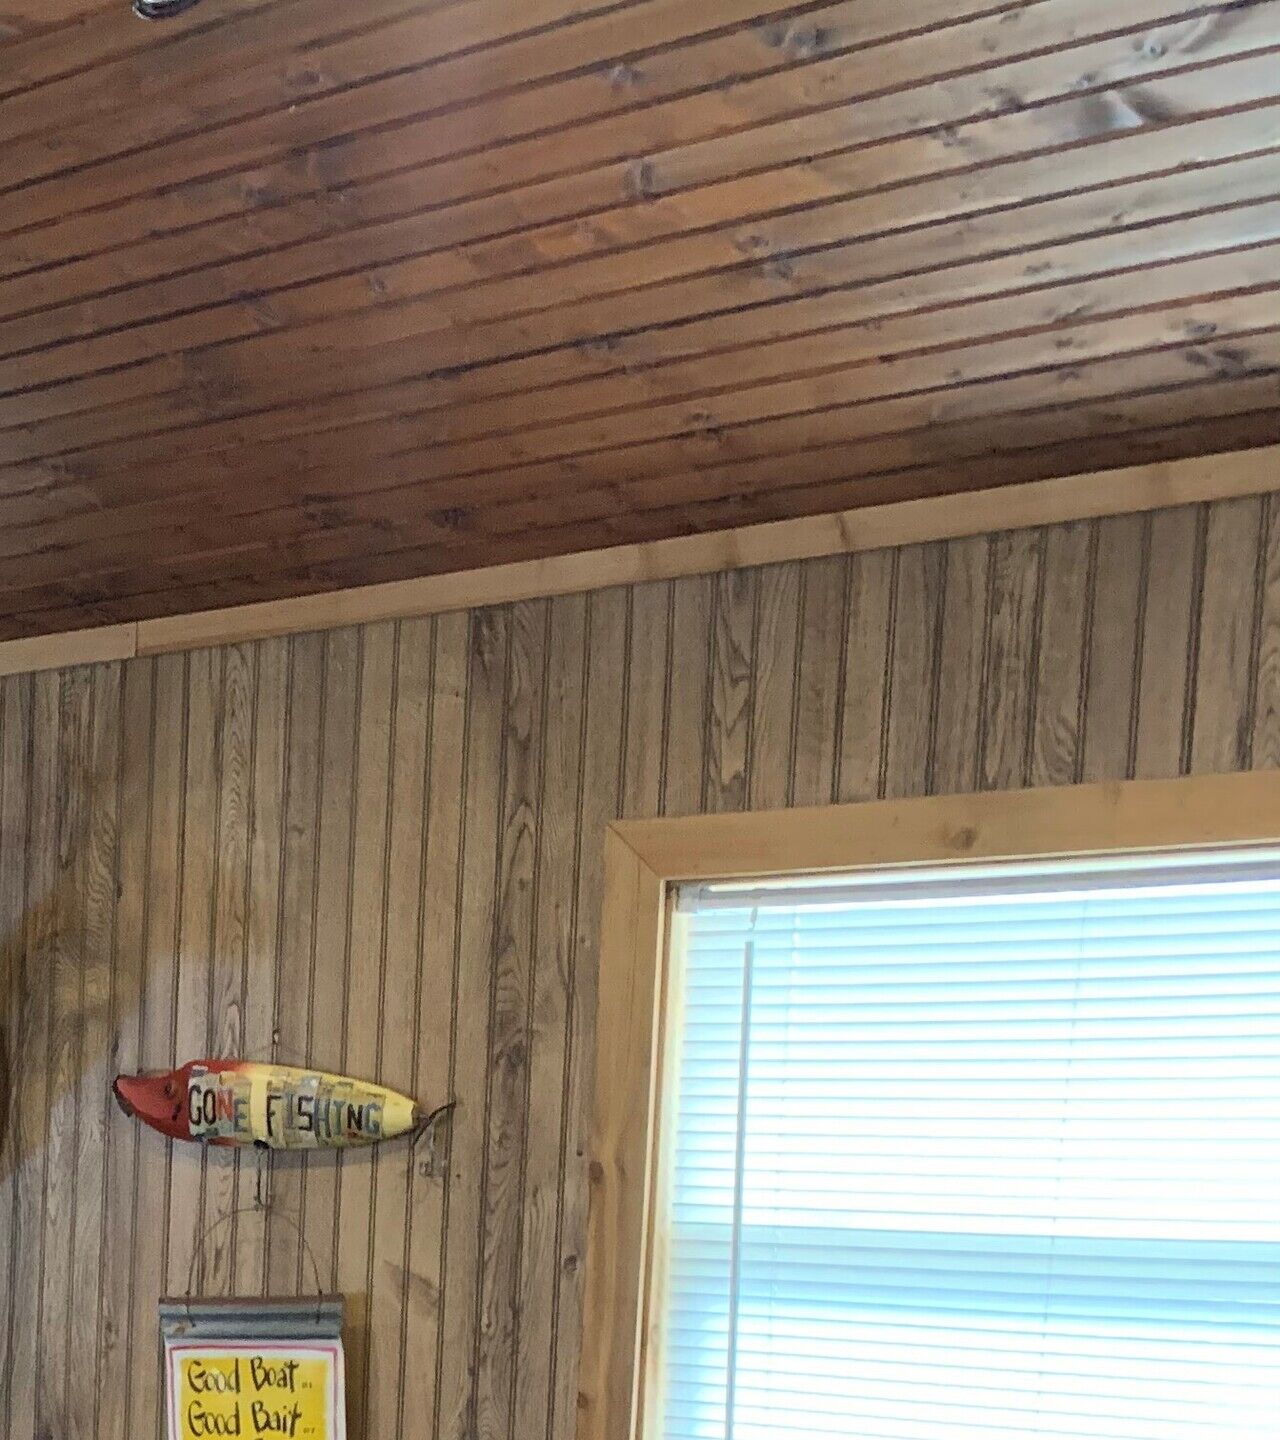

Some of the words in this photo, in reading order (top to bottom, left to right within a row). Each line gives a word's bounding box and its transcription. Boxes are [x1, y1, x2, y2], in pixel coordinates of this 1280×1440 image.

[189, 1084, 248, 1133] GONE
[187, 1357, 241, 1394] Good
[187, 1400, 242, 1437] Good
